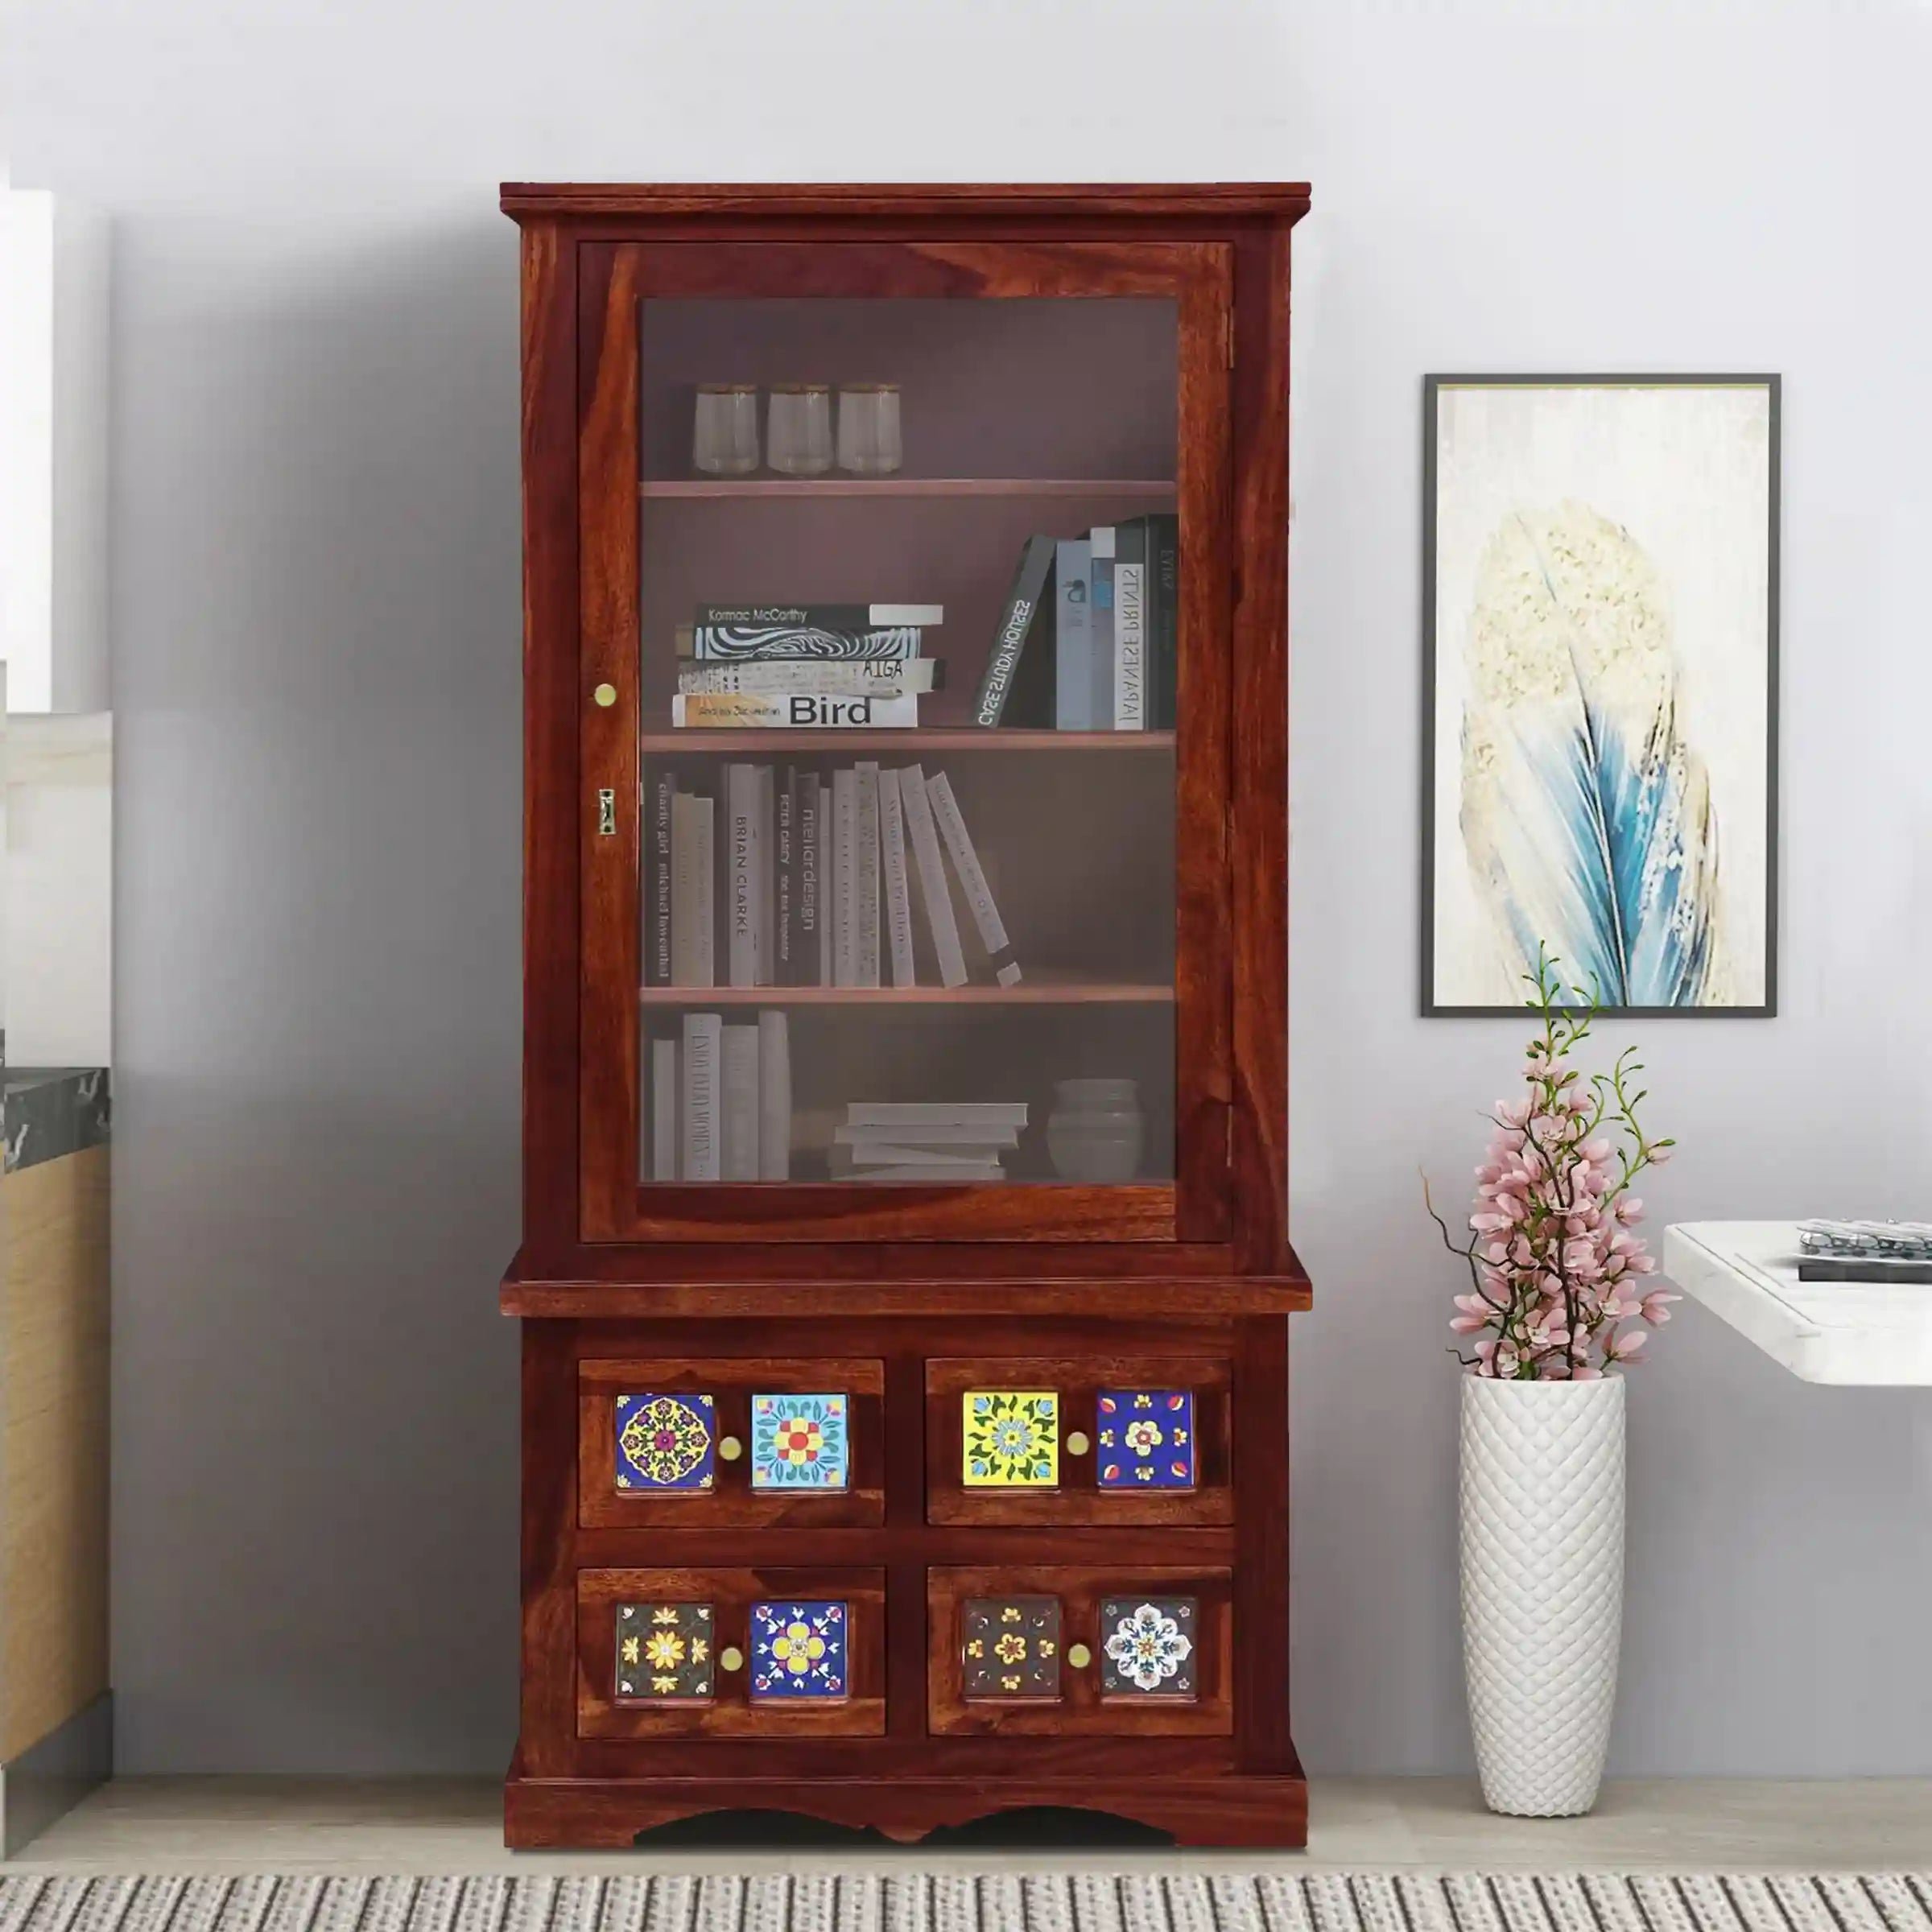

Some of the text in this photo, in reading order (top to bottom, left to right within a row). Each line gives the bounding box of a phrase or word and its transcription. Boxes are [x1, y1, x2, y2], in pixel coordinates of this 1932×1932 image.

[753, 608, 807, 624] McCarthy
[863, 660, 903, 679] AIGA
[790, 696, 870, 724] Bird
[736, 816, 748, 937] BRIAN CLARKE
